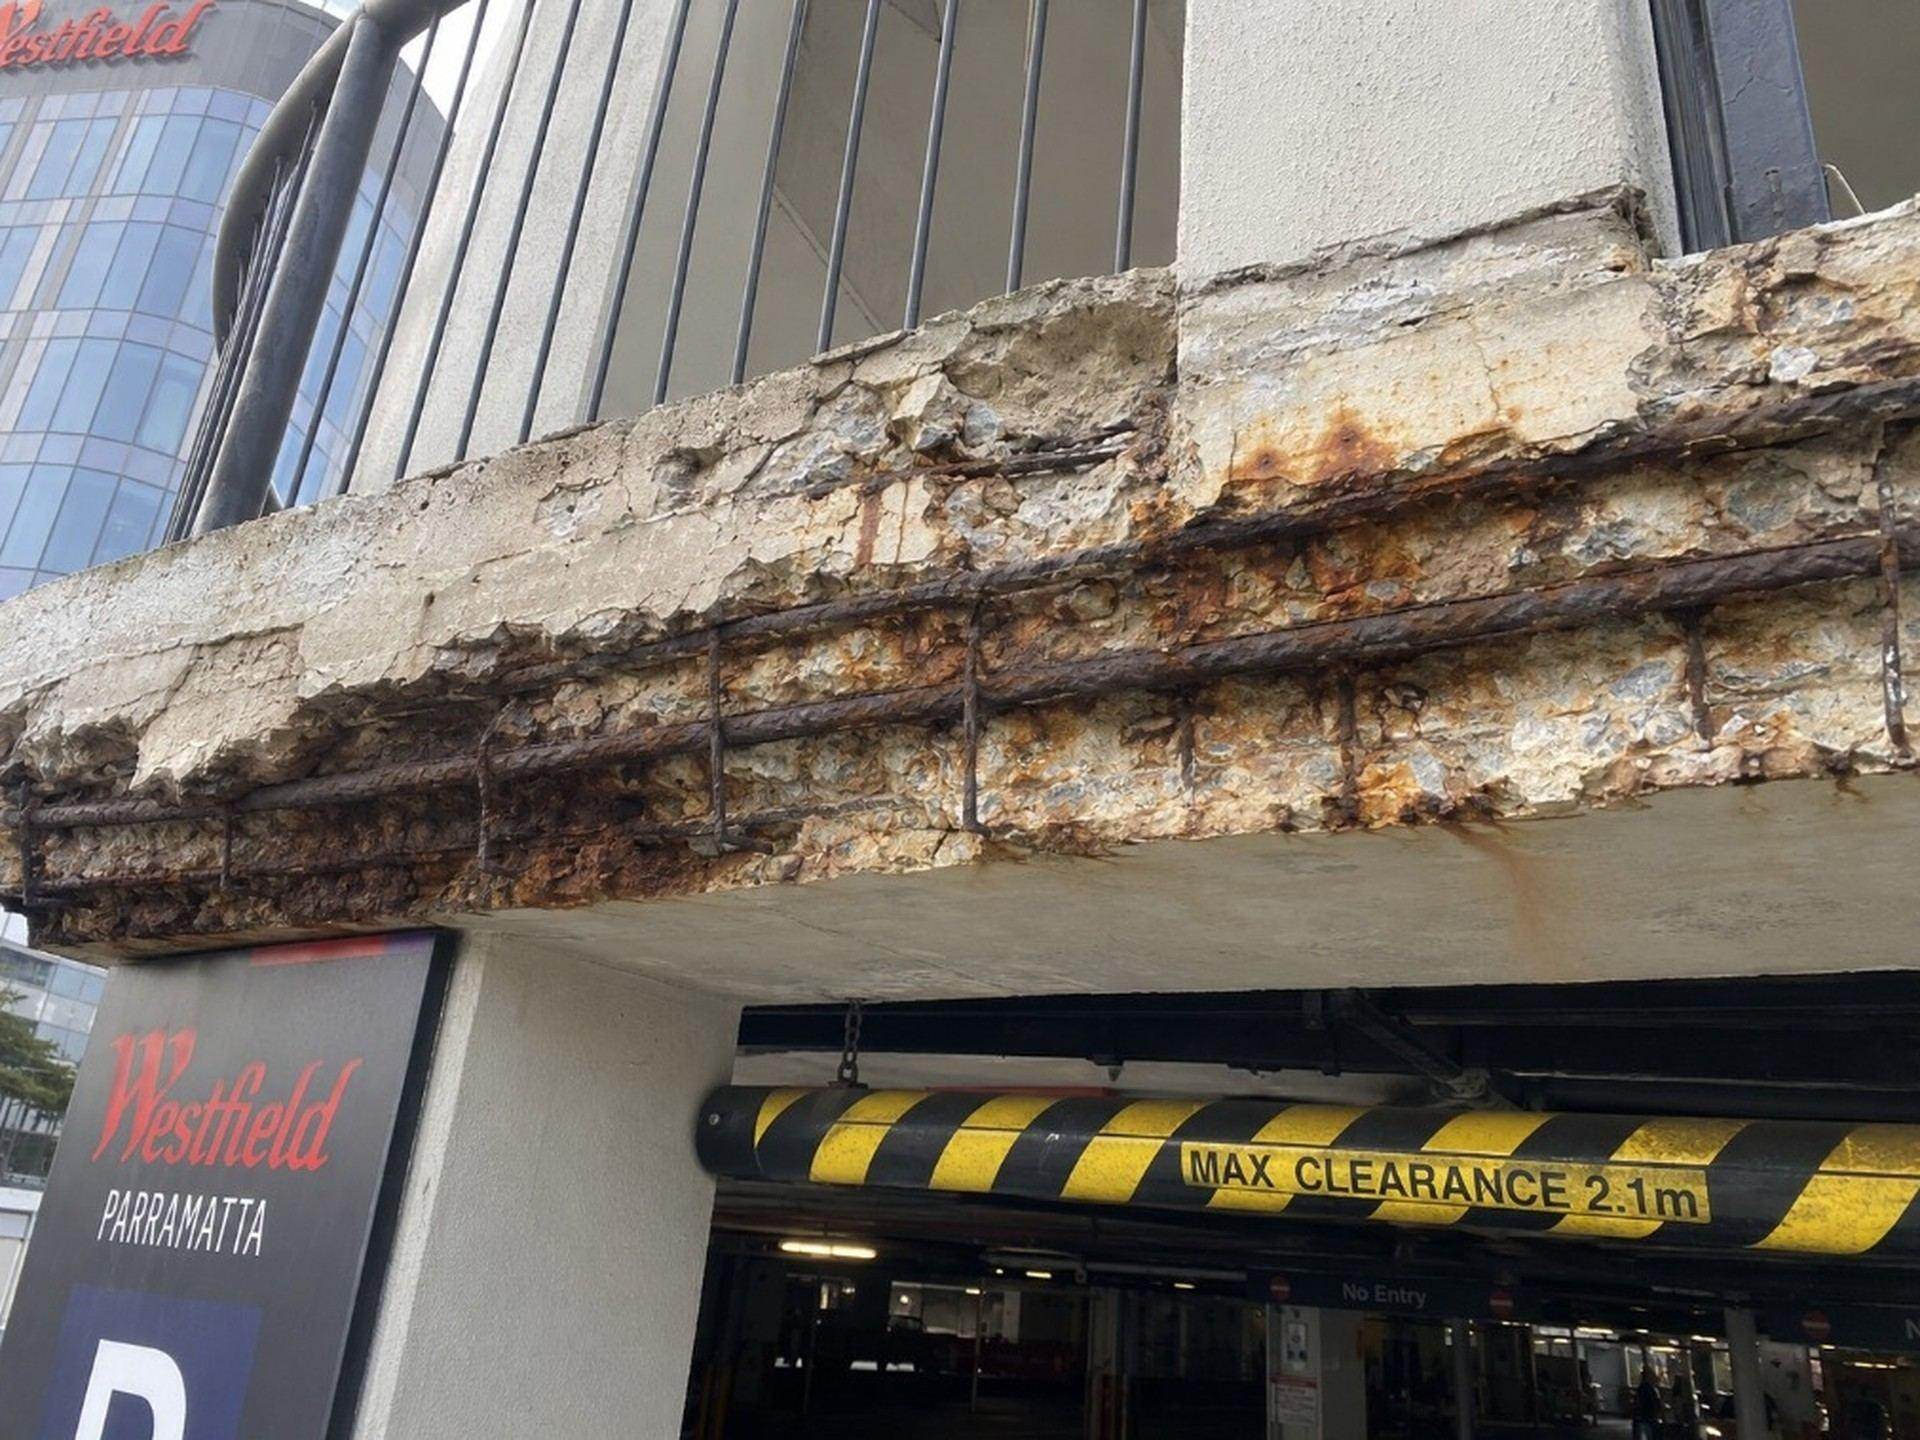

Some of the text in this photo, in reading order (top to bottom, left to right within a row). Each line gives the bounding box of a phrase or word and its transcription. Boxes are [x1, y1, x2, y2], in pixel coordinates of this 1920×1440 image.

[92, 1026, 363, 1172] Westfield
[1190, 1150, 1699, 1218] MAX CLEARANCE 2.1m
[98, 1189, 267, 1257] PARRAMATTA
[1342, 1282, 1427, 1309] No Entry
